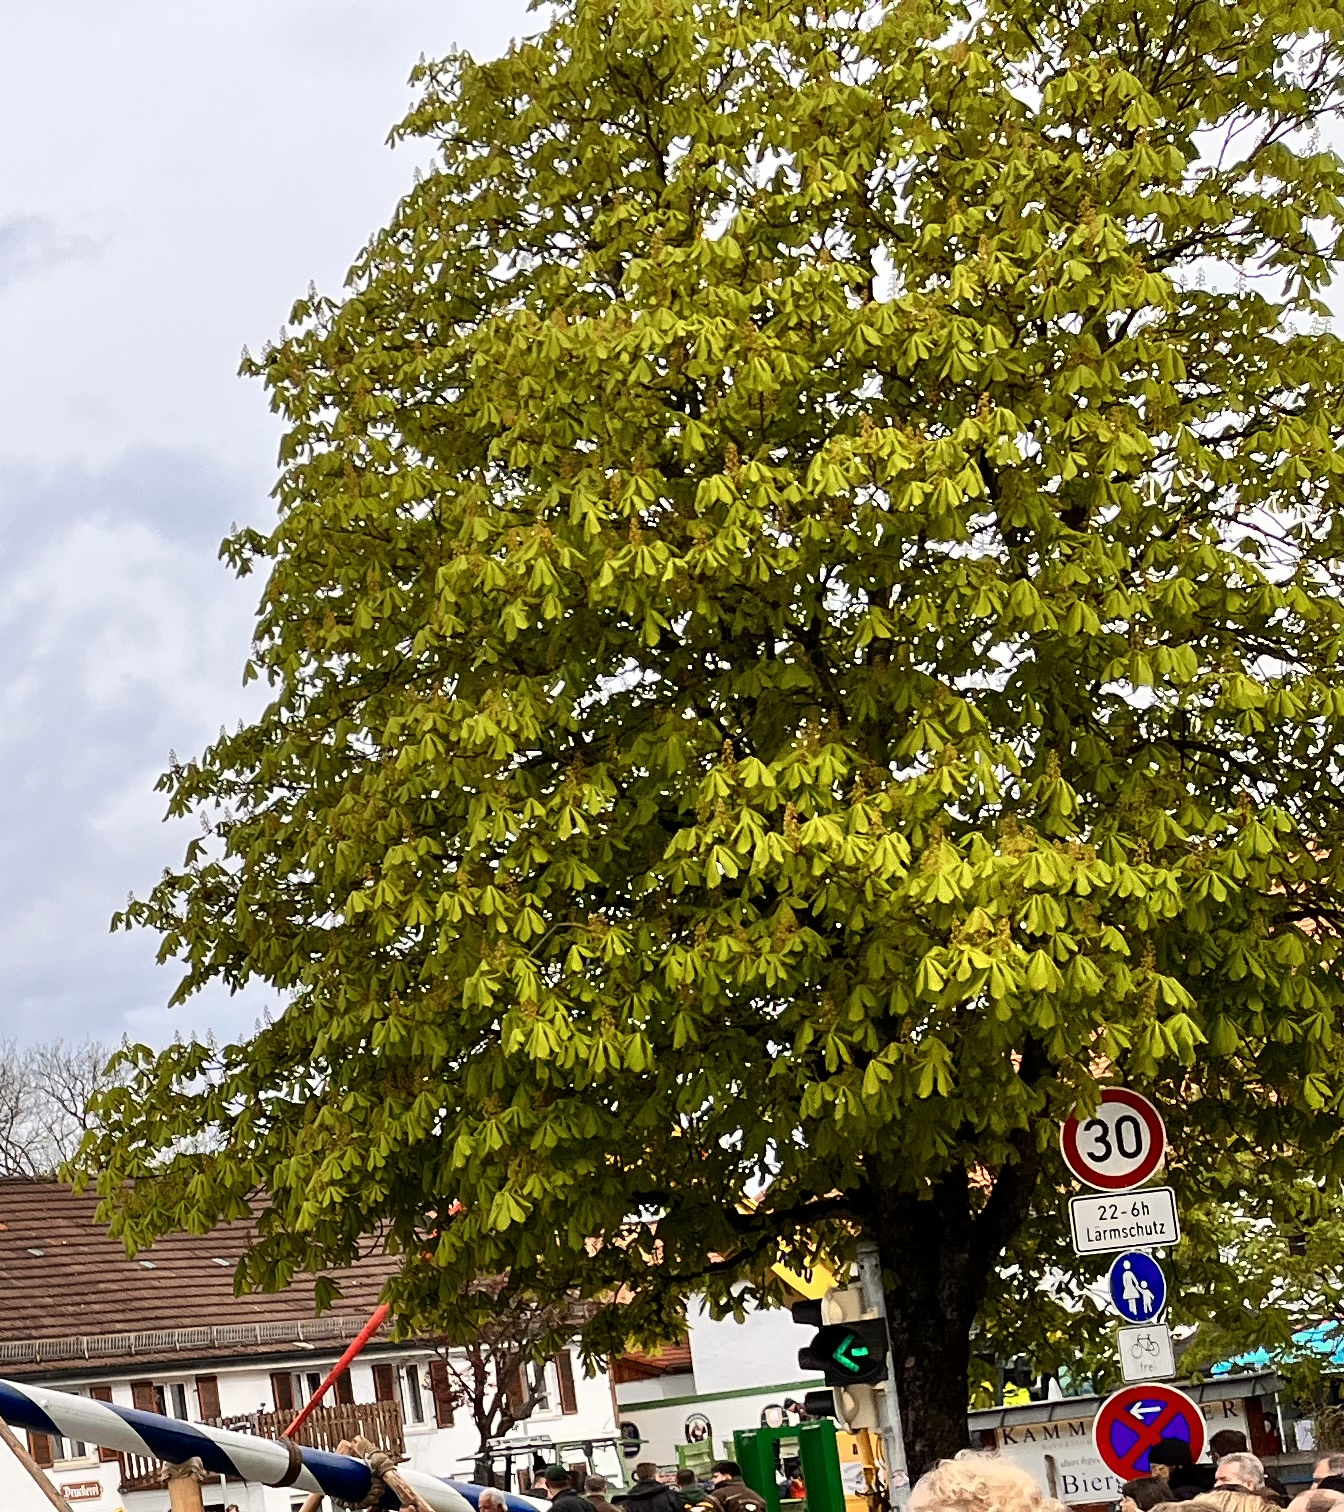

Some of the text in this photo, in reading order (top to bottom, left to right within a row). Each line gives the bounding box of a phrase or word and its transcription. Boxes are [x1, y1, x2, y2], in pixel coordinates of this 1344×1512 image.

[1083, 1114, 1143, 1163] 30
[1097, 1201, 1150, 1221] 22-6h
[1086, 1221, 1166, 1242] Lärmschutz
